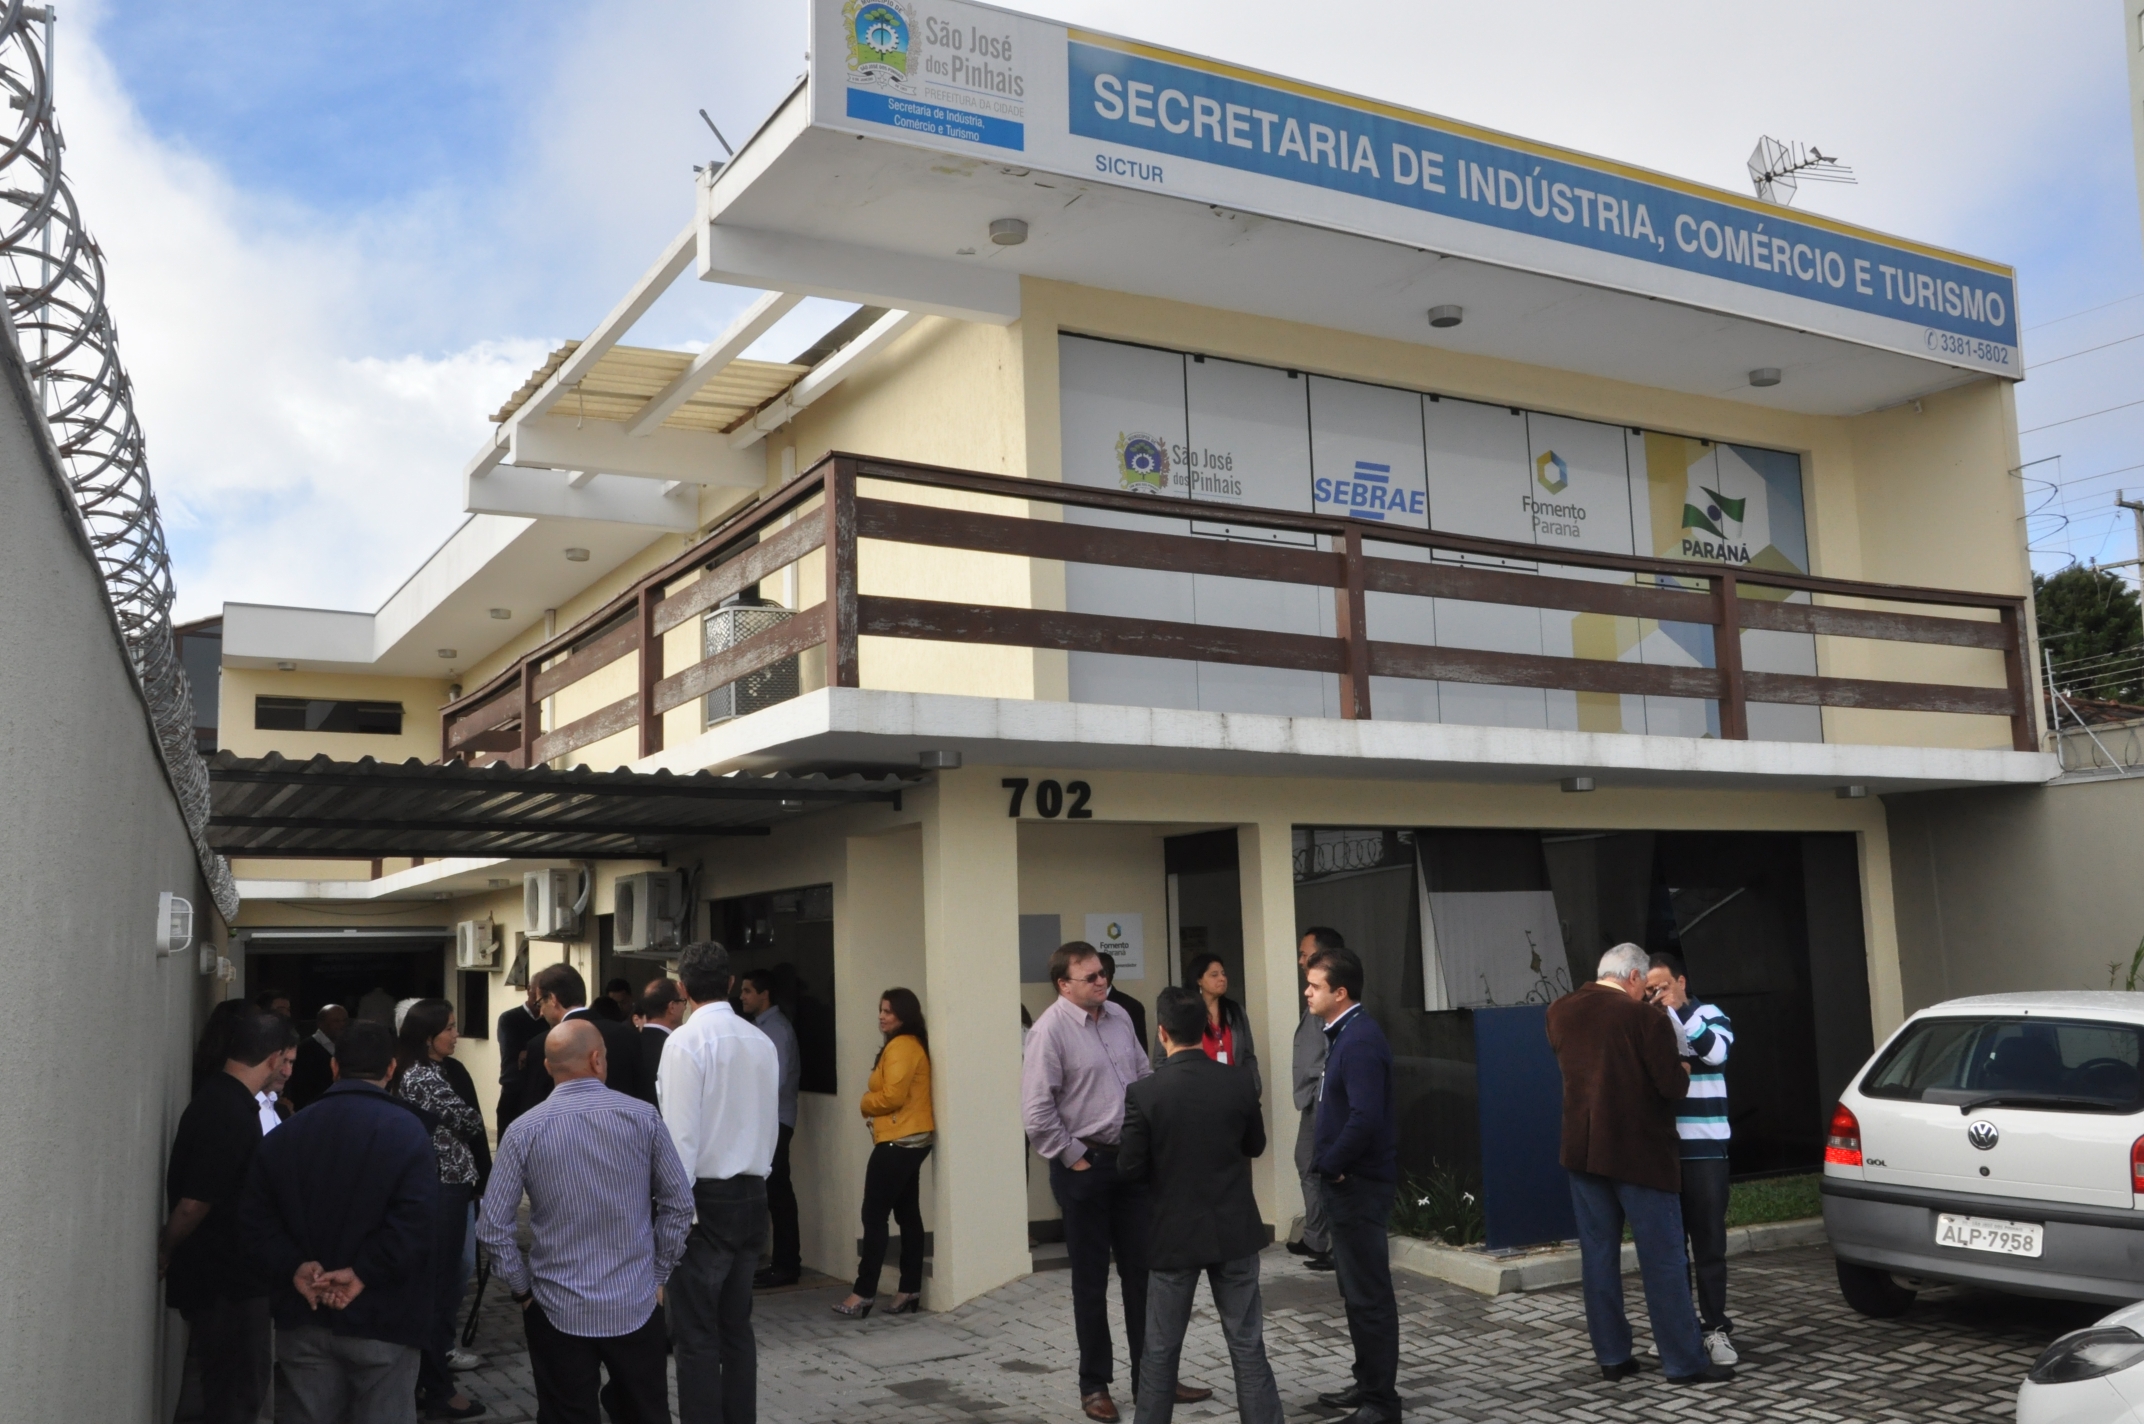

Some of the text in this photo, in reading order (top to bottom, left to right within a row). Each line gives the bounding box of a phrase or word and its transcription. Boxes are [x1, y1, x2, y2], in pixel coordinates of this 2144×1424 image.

[926, 16, 1012, 62] São José
[925, 54, 1025, 97] dos Pinhais
[888, 98, 985, 129] Secretaria de Indústria,
[924, 87, 978, 109] PREFEITURA
[979, 99, 992, 111] DA
[993, 101, 1025, 118] CIDADE
[894, 113, 980, 142] Comércio e Turismo
[1095, 154, 1164, 183] SICTUR
[1093, 73, 2006, 328] SECRETARIA DE INDÚSTRIA, COMÉRCIO E TURISMO
[1940, 333, 2009, 365] 3381-5802
[1172, 444, 1233, 471] São José
[1173, 470, 1243, 497] dos Pinhais
[1314, 477, 1426, 515] SEBRAE
[1522, 495, 1587, 520] Fomento
[1532, 515, 1581, 538] Paraná
[1681, 539, 1751, 564] PARANÁ
[1002, 778, 1093, 819] 702
[1100, 941, 1130, 949] Fomento
[1866, 1158, 1887, 1167] GOL
